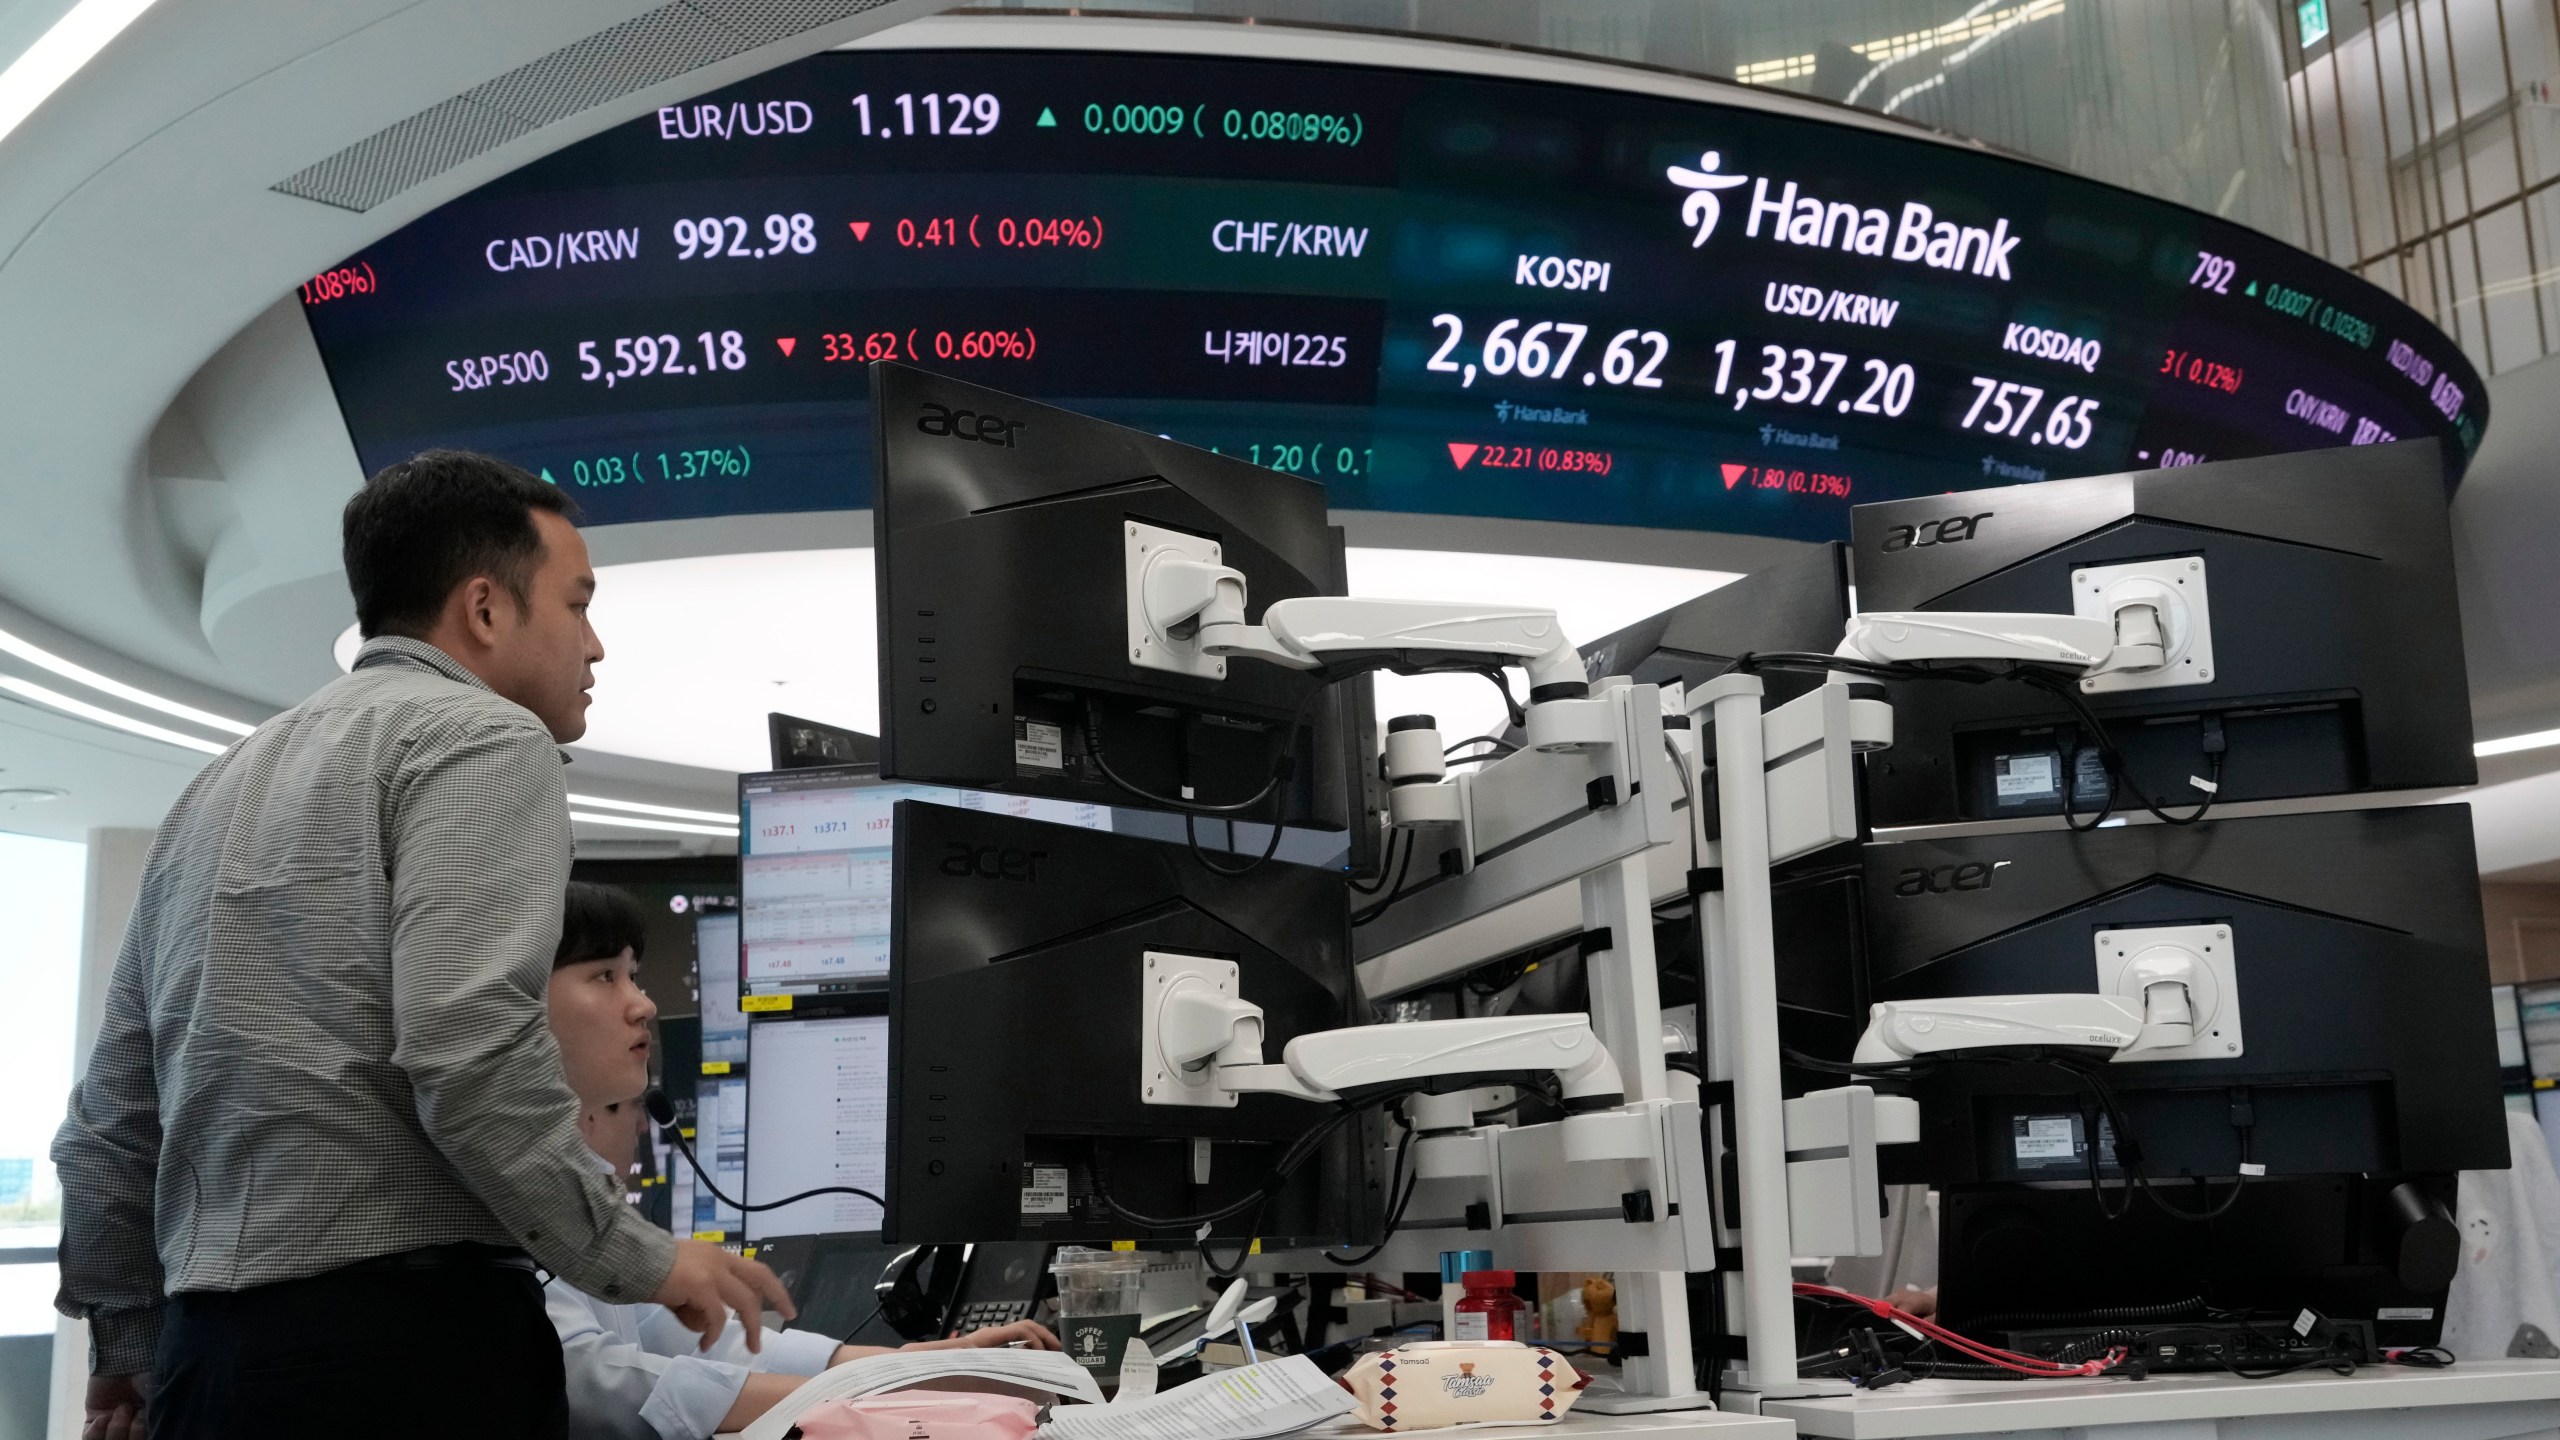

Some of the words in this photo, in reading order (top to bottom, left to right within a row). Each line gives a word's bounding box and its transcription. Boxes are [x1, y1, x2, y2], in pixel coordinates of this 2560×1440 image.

[658, 101, 812, 140] EUR/USD
[852, 93, 1000, 138] 1.1129
[486, 227, 639, 272] CAD/KRW
[674, 213, 817, 260] 992.98
[1212, 219, 1368, 258] CHF/KRW
[1746, 176, 1889, 257] Hana
[1893, 202, 2021, 281] Bank
[1516, 254, 1611, 293] KOSPI
[2189, 251, 2236, 295] 792
[1765, 281, 1900, 329] USD/KRW
[446, 349, 549, 392] S&P500
[579, 331, 747, 388] 5,592.18
[1205, 330, 1347, 367] 니케이225
[1427, 314, 1669, 389] 2,667.62
[2003, 322, 2102, 374] KOSDAQ
[1714, 339, 1916, 418] 1,337.20
[917, 402, 1026, 448] acer
[1961, 377, 2100, 450] 757.65
[1482, 444, 1533, 469] 22.21
[1538, 447, 1613, 476] (0.83%)
[1751, 467, 1785, 489] 1.80
[1787, 470, 1852, 498] (0.13%)
[1881, 511, 1994, 554] acer
[939, 842, 1049, 881] acer
[1894, 860, 2012, 898] acer
[1075, 1327, 1103, 1338] COFFEE
[1077, 1356, 1105, 1364] SQUARE
